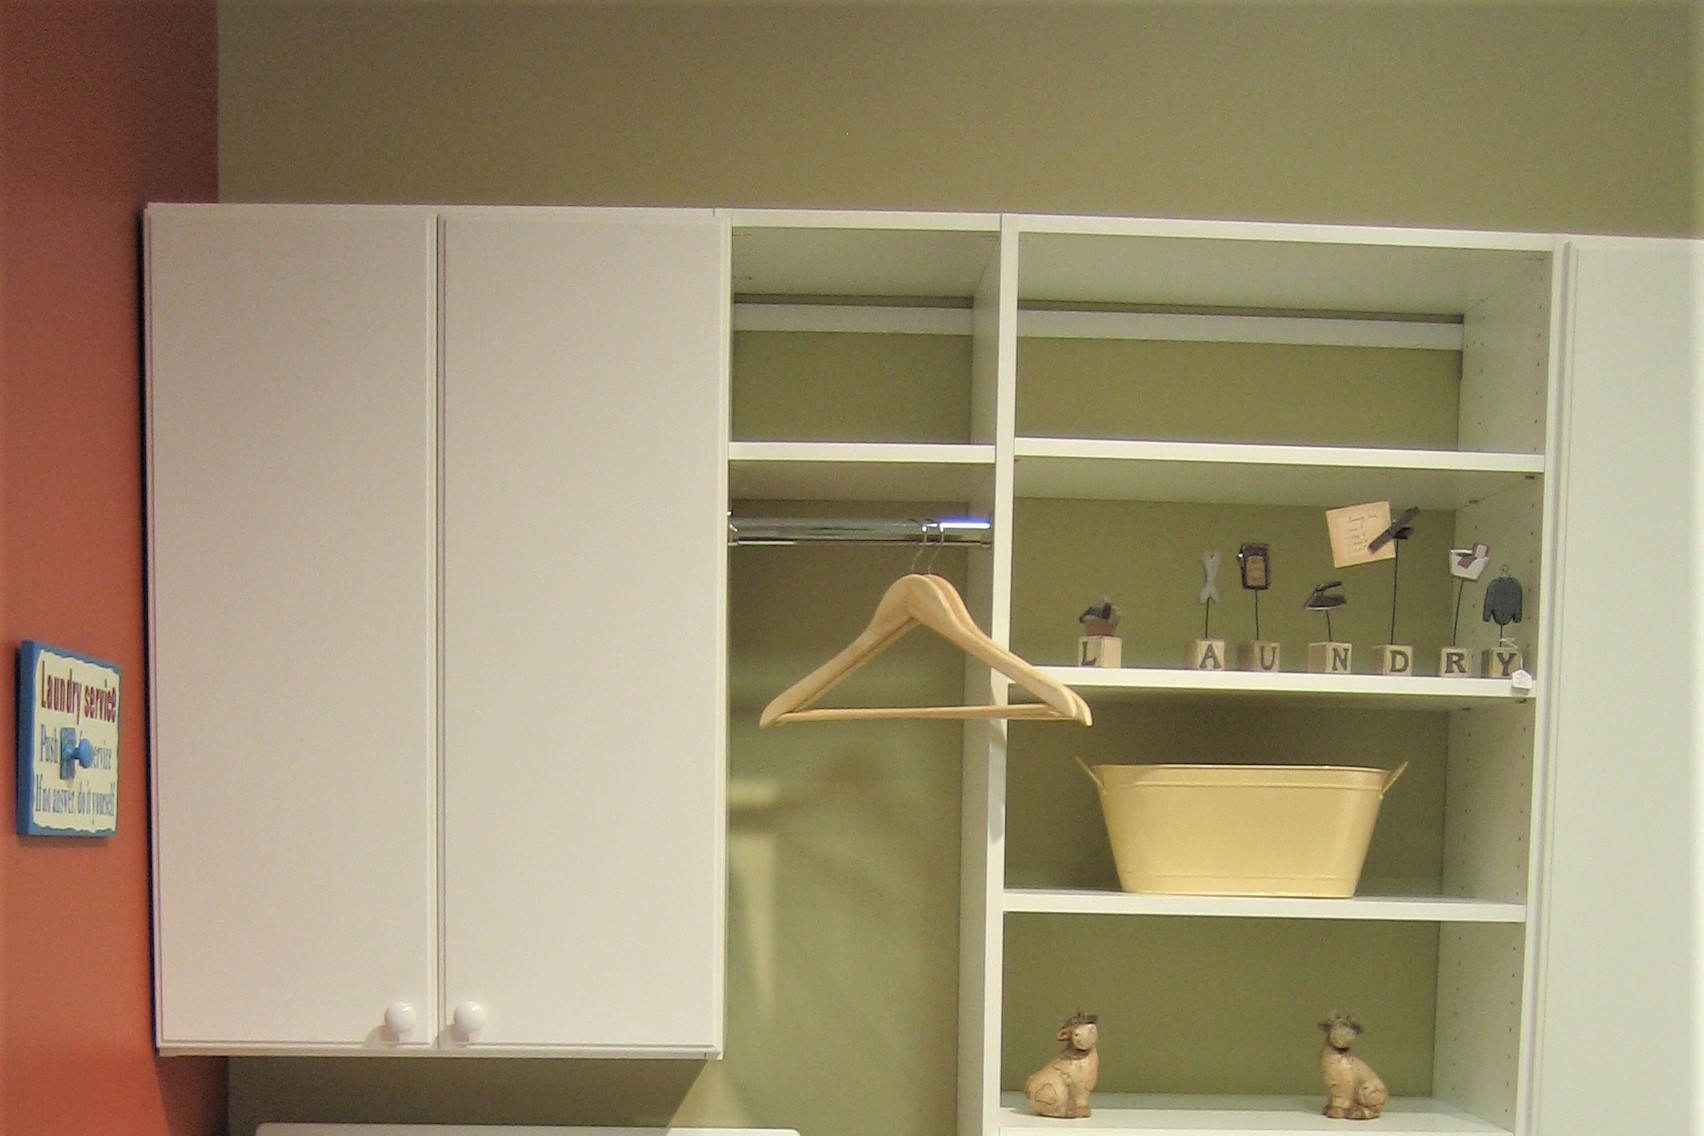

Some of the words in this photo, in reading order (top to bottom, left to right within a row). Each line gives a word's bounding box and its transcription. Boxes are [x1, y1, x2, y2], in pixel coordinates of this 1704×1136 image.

[41, 660, 82, 725] Laundry
[84, 678, 117, 724] service
[40, 723, 59, 764] Push
[89, 739, 112, 771] ervice
[35, 773, 43, 812] If
[78, 781, 86, 815] do
